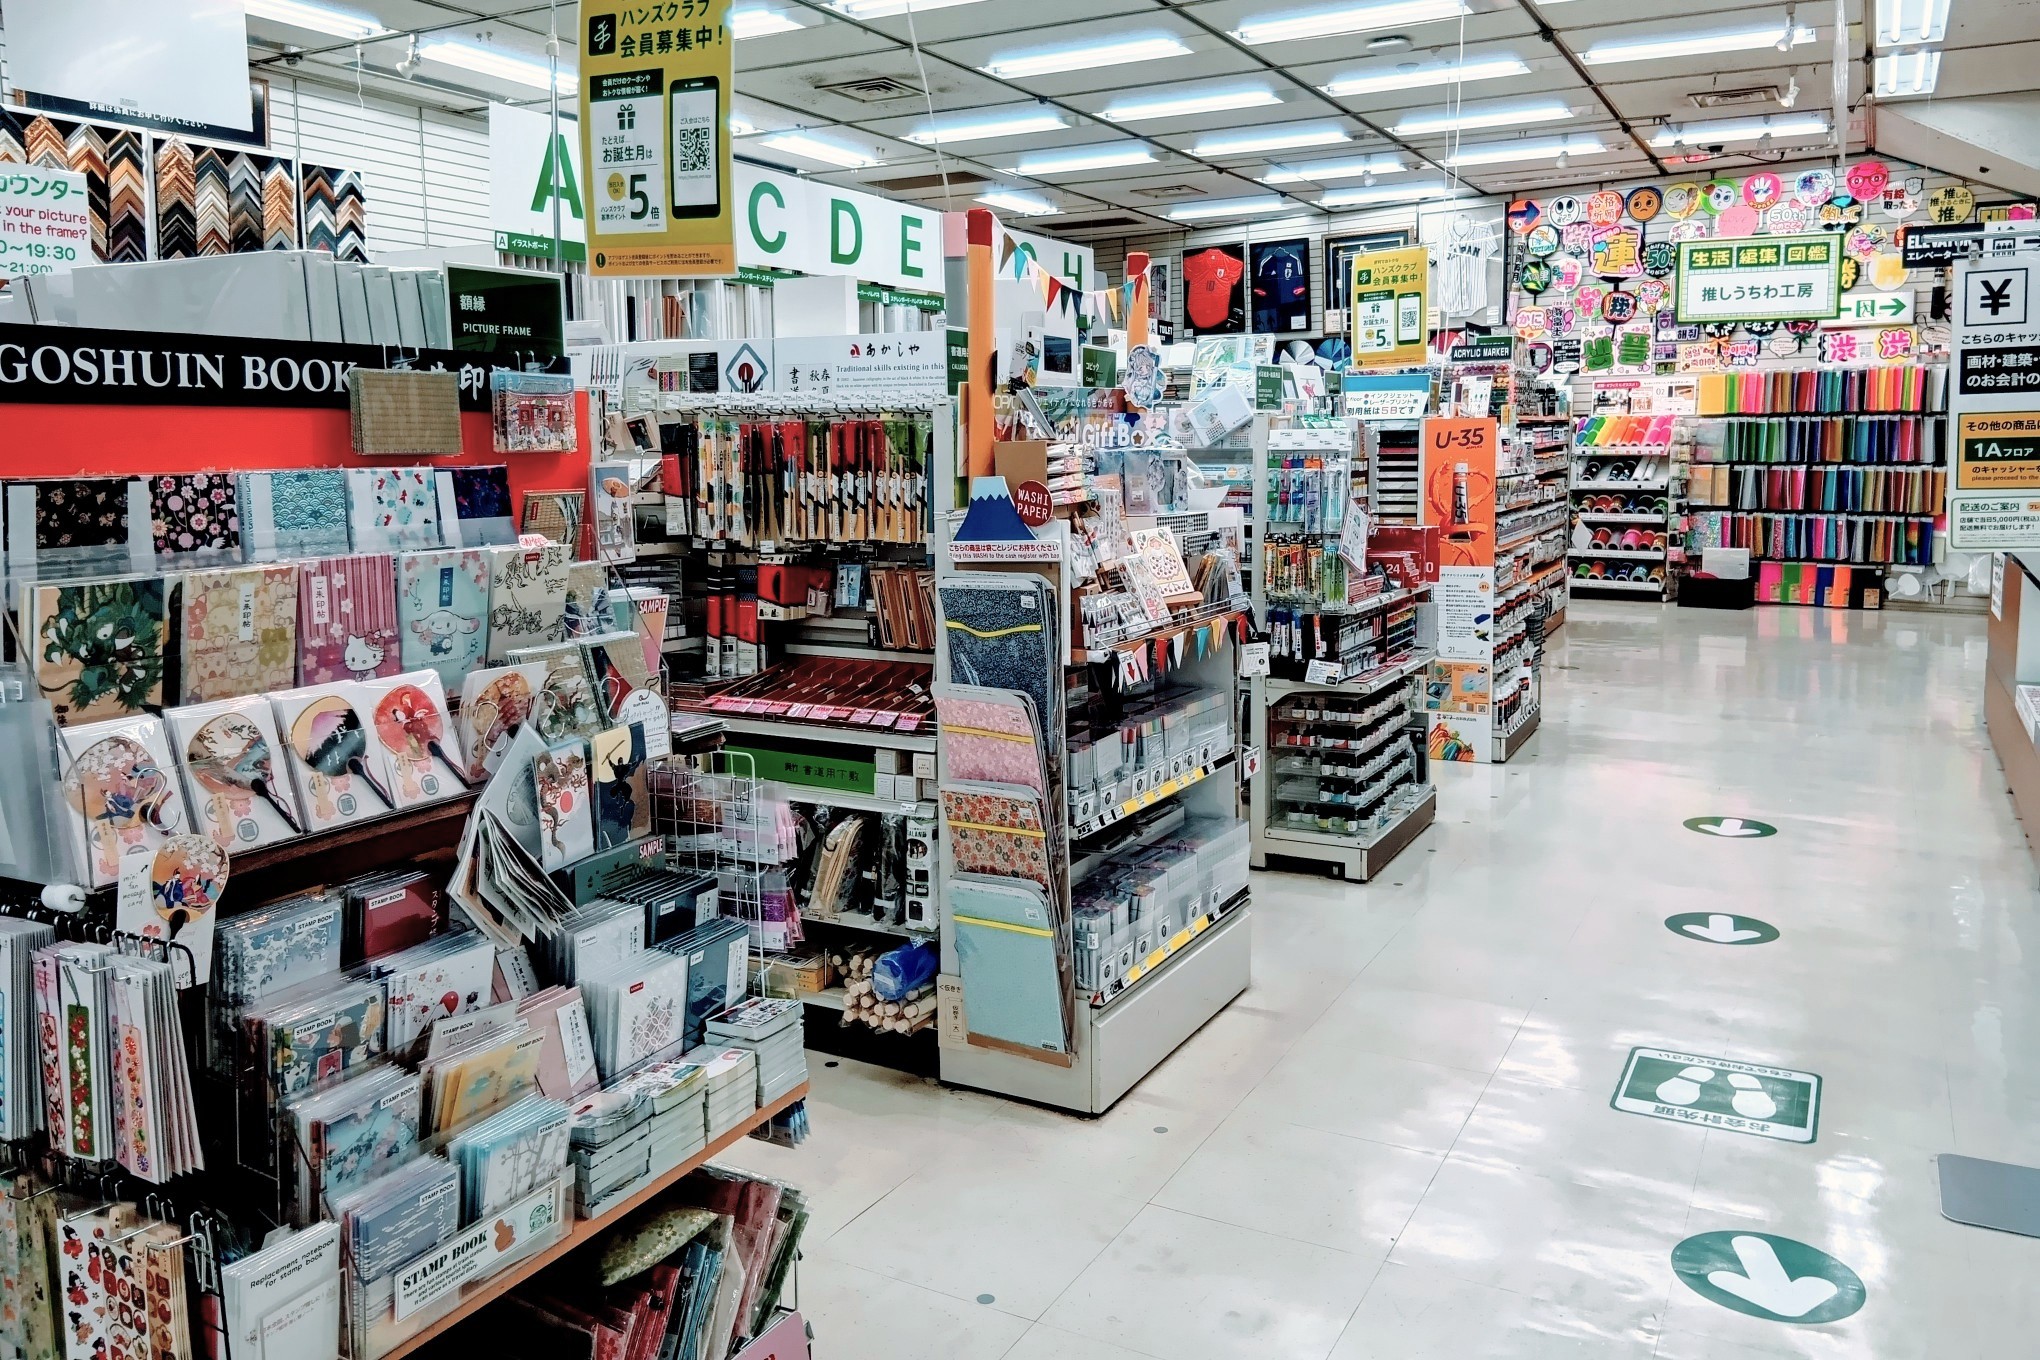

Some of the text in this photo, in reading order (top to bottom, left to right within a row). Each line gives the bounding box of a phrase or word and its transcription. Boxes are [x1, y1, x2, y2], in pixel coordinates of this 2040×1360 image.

[620, 25, 723, 58] 会員募集中!
[602, 145, 653, 163] お誕生月は
[629, 174, 660, 220] 5 倍
[1883, 188, 1905, 200] 有給
[1930, 197, 1971, 207] 推せるときに
[1944, 188, 1969, 199] 推しは
[1883, 200, 1918, 210] 取ったよ
[6, 206, 87, 224] your picture
[1938, 206, 1962, 222] 推せ
[3, 220, 88, 240] in the frame?
[748, 181, 787, 254] C
[831, 198, 863, 265] D
[901, 214, 924, 278] E
[499, 236, 506, 248] A
[511, 238, 549, 250] イラストボード
[1647, 249, 1671, 269] 50
[1691, 245, 1828, 267] 生活 編集 図鑑
[1907, 251, 1960, 260] エレベーター
[1064, 251, 1083, 290] 4
[1373, 263, 1417, 274] ハンズクラブ
[1523, 269, 1549, 281] 大の里
[1373, 274, 1423, 286] 会員募集中!
[1702, 282, 1814, 302] 推しうちわ工房
[459, 294, 486, 312] 額縁
[1519, 314, 1542, 325] かに
[462, 322, 532, 336] PICTURE FRAME
[1159, 324, 1173, 336] TOILET
[1376, 329, 1386, 347] 5
[1830, 330, 1910, 361] 渋 渋
[1961, 333, 2040, 345] こちらのキャッ
[865, 341, 920, 358] あかしや
[1453, 347, 1510, 359] ACRYLIC MARKER
[0, 343, 224, 389] GOSHUIN
[836, 364, 872, 373] Traditional
[874, 364, 892, 372] skills
[893, 363, 920, 373] existing
[931, 362, 945, 370] this
[1085, 362, 1100, 371] コピック
[1967, 353, 2040, 369] 画材・建築・
[1967, 373, 2040, 387] のお会計の
[1435, 427, 1485, 449] U-35
[1974, 443, 2034, 458] 1Aフロア
[1018, 488, 1049, 506] WASHI
[1455, 486, 1467, 519] U-35
[1017, 503, 1048, 520] PAPER
[1960, 502, 2020, 512] 配送のご案内
[949, 544, 1059, 552] こちらの商品は袋ごとレジにお持ちください
[316, 581, 327, 619] ご朱印帖
[638, 599, 668, 614] SAMPLE
[242, 594, 252, 628] ご朱印帖
[803, 765, 859, 782] 書道用下敷
[639, 838, 664, 859] SAMPLE
[123, 873, 139, 882] mini
[122, 889, 147, 901] message
[127, 899, 144, 908] card
[371, 892, 404, 907] STAMP BOOK
[298, 914, 333, 930] STAMP BOOK
[296, 1018, 333, 1036] STAMP BOOK
[442, 1021, 474, 1036] STAMP BOOK
[516, 1036, 544, 1050] STAMP BOOK
[1659, 1052, 1793, 1078] こちらでお待ちください
[382, 1086, 415, 1107] STAMP BOOK
[539, 1118, 567, 1134] STAMP BOOK
[1654, 1104, 1771, 1133] お会計先頭
[421, 1183, 455, 1203] STAMP BOOK
[250, 1238, 335, 1289] Replacement notebook
[403, 1229, 488, 1291] STAMP BOOK
[265, 1252, 323, 1288] for stamp book
[404, 1288, 418, 1299] There
[427, 1278, 435, 1286] fun
[435, 1267, 452, 1280] stamps
[458, 1256, 470, 1266] train
[470, 1245, 488, 1258] stations
[418, 1288, 428, 1297] and
[428, 1278, 446, 1290] various
[446, 1268, 461, 1280] tourist
[429, 1287, 442, 1298] serve
[452, 1271, 466, 1282] travel
